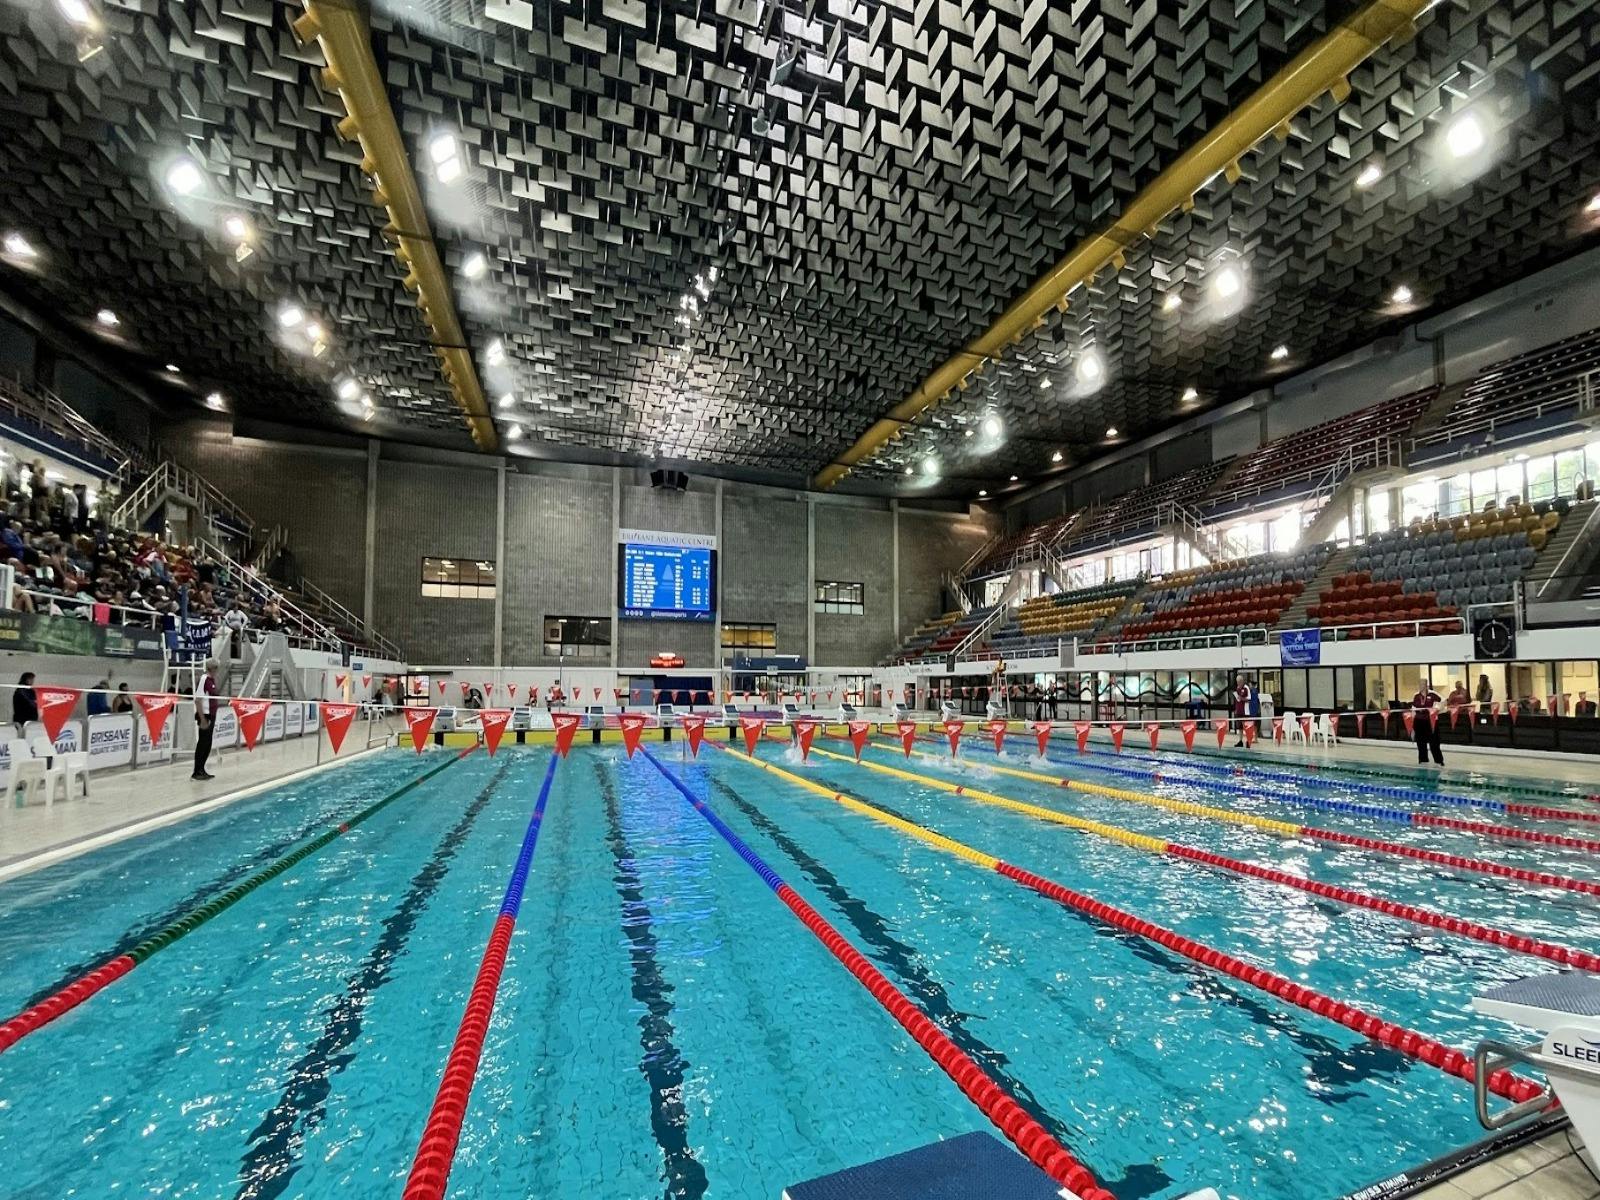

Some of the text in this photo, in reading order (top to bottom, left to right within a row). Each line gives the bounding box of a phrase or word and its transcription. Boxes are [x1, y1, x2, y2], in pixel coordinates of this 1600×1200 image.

[91, 728, 130, 744] BRISBANE
[1552, 1042, 1600, 1064] SLEE
[1379, 1173, 1408, 1191] TIMING
